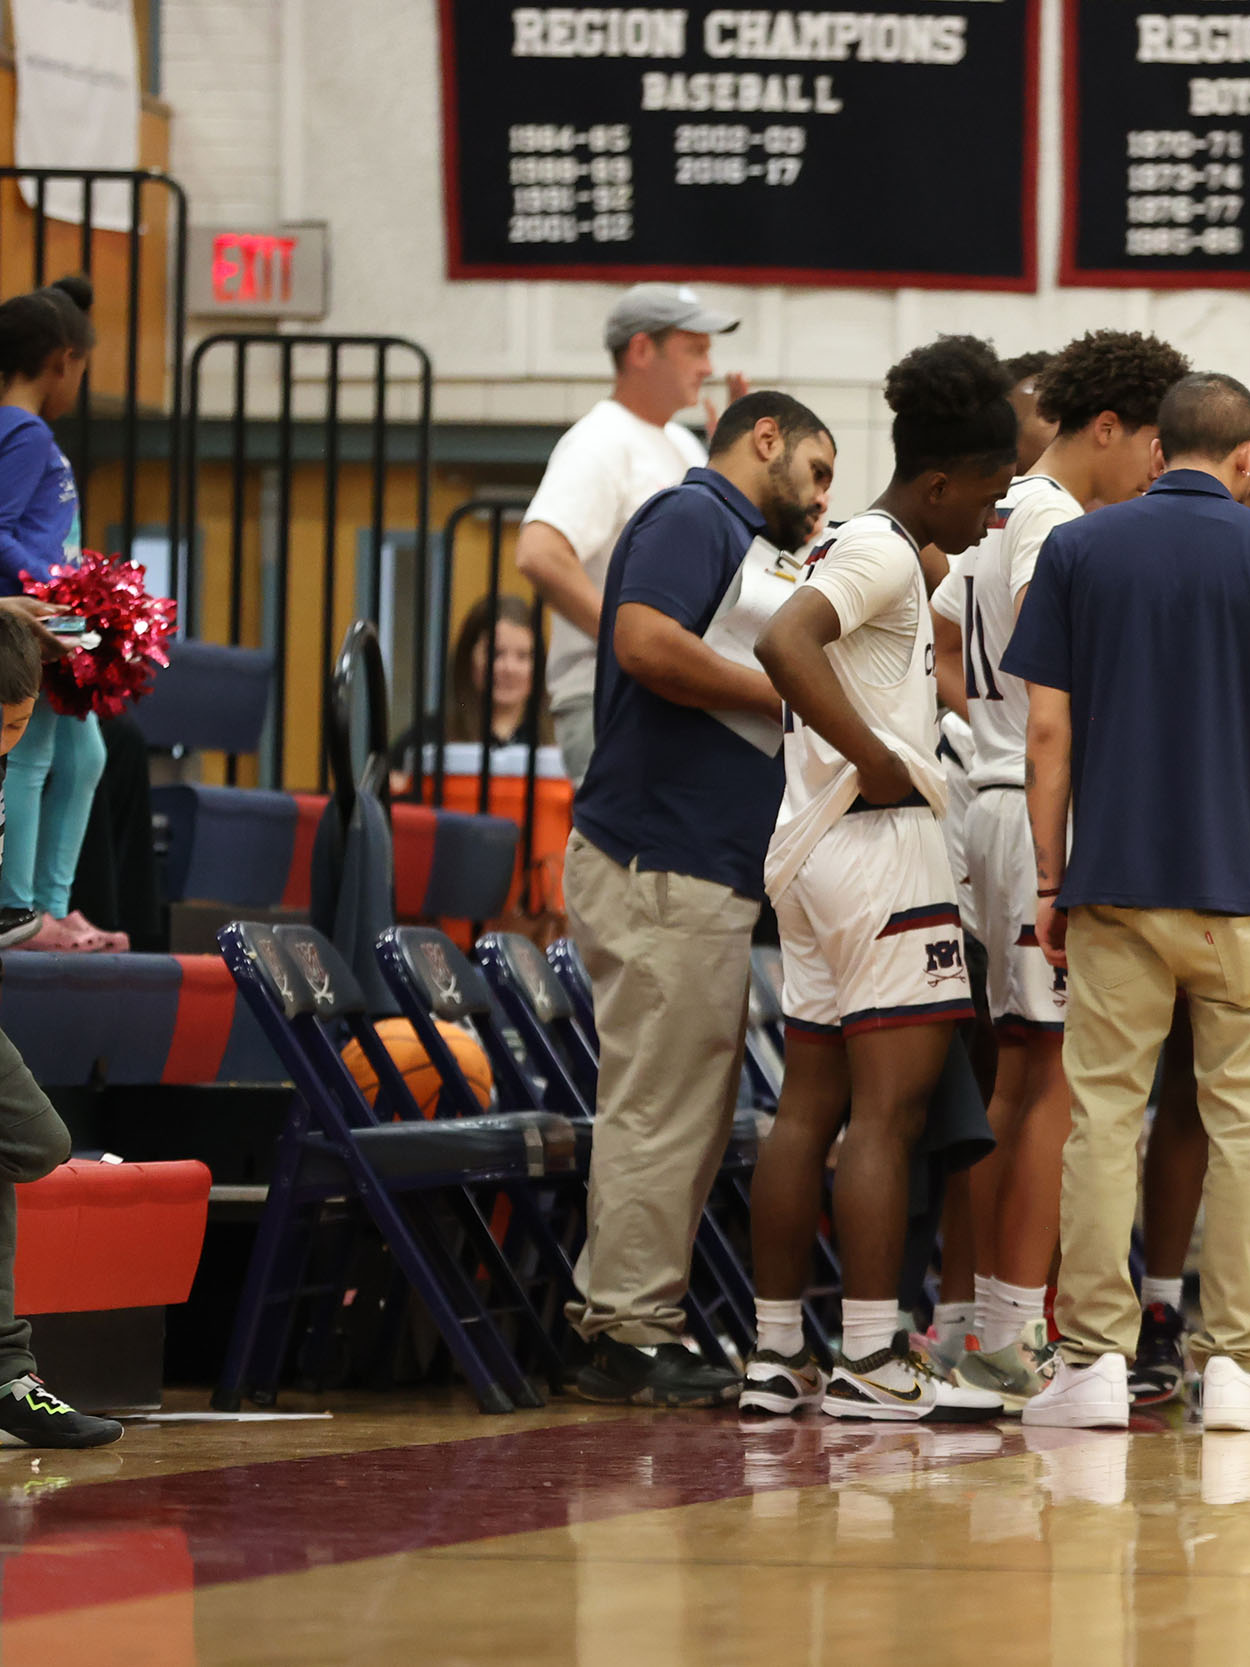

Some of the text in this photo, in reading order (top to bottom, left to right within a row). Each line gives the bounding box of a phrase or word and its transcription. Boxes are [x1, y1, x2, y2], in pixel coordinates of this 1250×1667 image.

[513, 8, 966, 64] REGION CHAMPIONS
[642, 72, 842, 113] BASEBALL
[213, 233, 296, 302] EXIT
